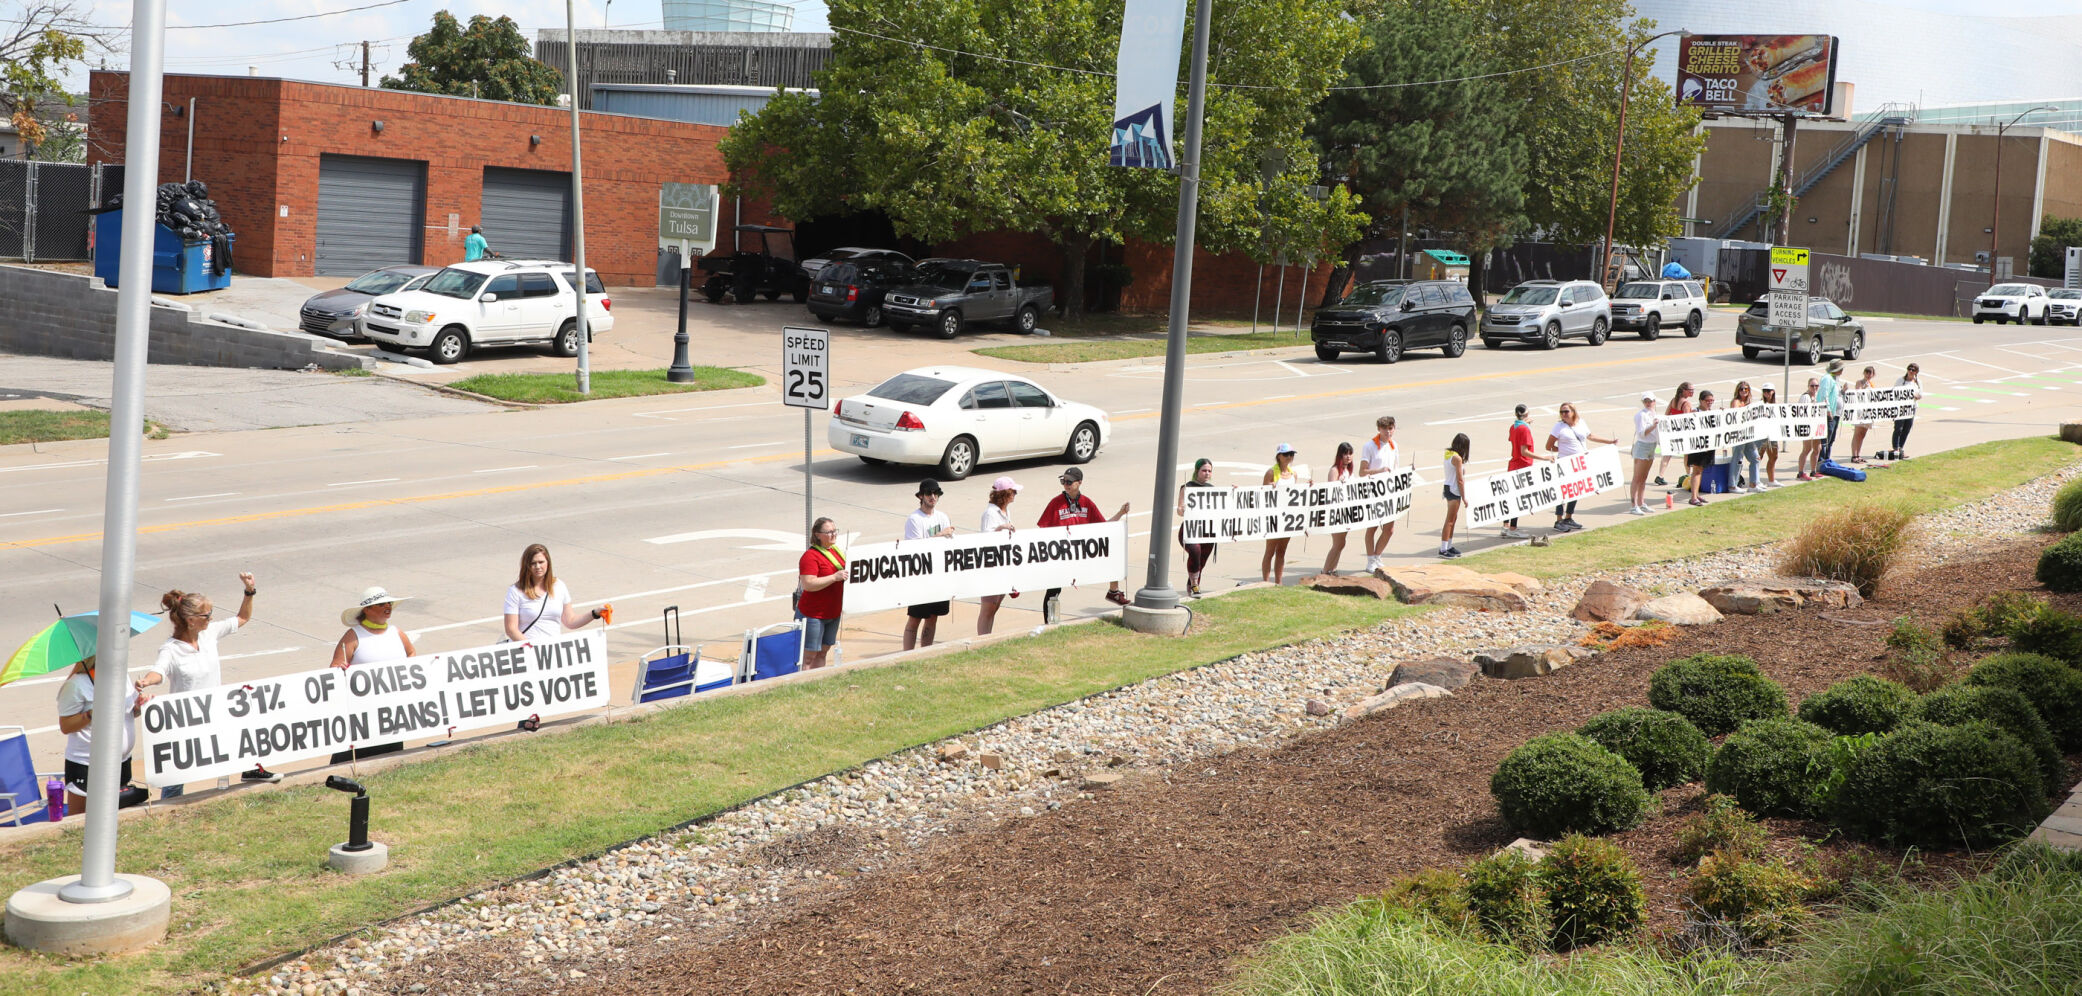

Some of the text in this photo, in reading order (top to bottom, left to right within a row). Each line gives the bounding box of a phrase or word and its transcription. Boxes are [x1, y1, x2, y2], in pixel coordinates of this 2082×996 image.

[1688, 47, 1741, 56] GRILLED
[1688, 56, 1738, 65] CHEESE
[1686, 65, 1740, 74] BURRITO
[1704, 78, 1738, 90] TACO
[1705, 90, 1736, 101] BELL
[669, 220, 698, 235] Tulsa
[1772, 257, 1796, 265] VEHICLES
[1774, 294, 1803, 302] PARKING
[1774, 302, 1802, 310] GARAGE
[1774, 310, 1801, 319] ACCESS
[1778, 319, 1796, 327] ONLY
[787, 337, 825, 351] SPEED
[791, 353, 820, 367] LIMIT
[789, 369, 824, 399] 25
[1894, 389, 1914, 401] MASKS
[1779, 406, 1787, 418] IS
[1791, 405, 1809, 418] SICK
[1811, 405, 1818, 418] OF
[1843, 409, 1854, 421] BUT
[1877, 406, 1898, 419] FORCED
[1900, 404, 1916, 417] BIRTH
[1700, 415, 1720, 429] KNEW
[1725, 412, 1738, 425] OK
[1780, 425, 1790, 437] WE
[1795, 424, 1811, 437] NEED
[1690, 435, 1709, 450] MADE
[1715, 433, 1722, 447] IT
[1491, 479, 1509, 496] PRO
[1541, 467, 1552, 482] IS
[1556, 463, 1565, 478] A
[1571, 456, 1587, 472] LIE
[1236, 491, 1260, 509] KNEW
[1309, 487, 1344, 507] DELAYS
[1386, 472, 1413, 493] CARE
[1473, 471, 1614, 522] STITT IS LETTING PEOPLE DIE
[1309, 510, 1325, 527] HE
[1329, 505, 1364, 526] BANNED
[850, 537, 1109, 583] EDUCATION PREVENTS ABORTION
[144, 638, 592, 733] ONLY 31% OF OKIES AGREE WITH
[153, 672, 597, 774] FULL ABORTION BANS! LET US VOTE
